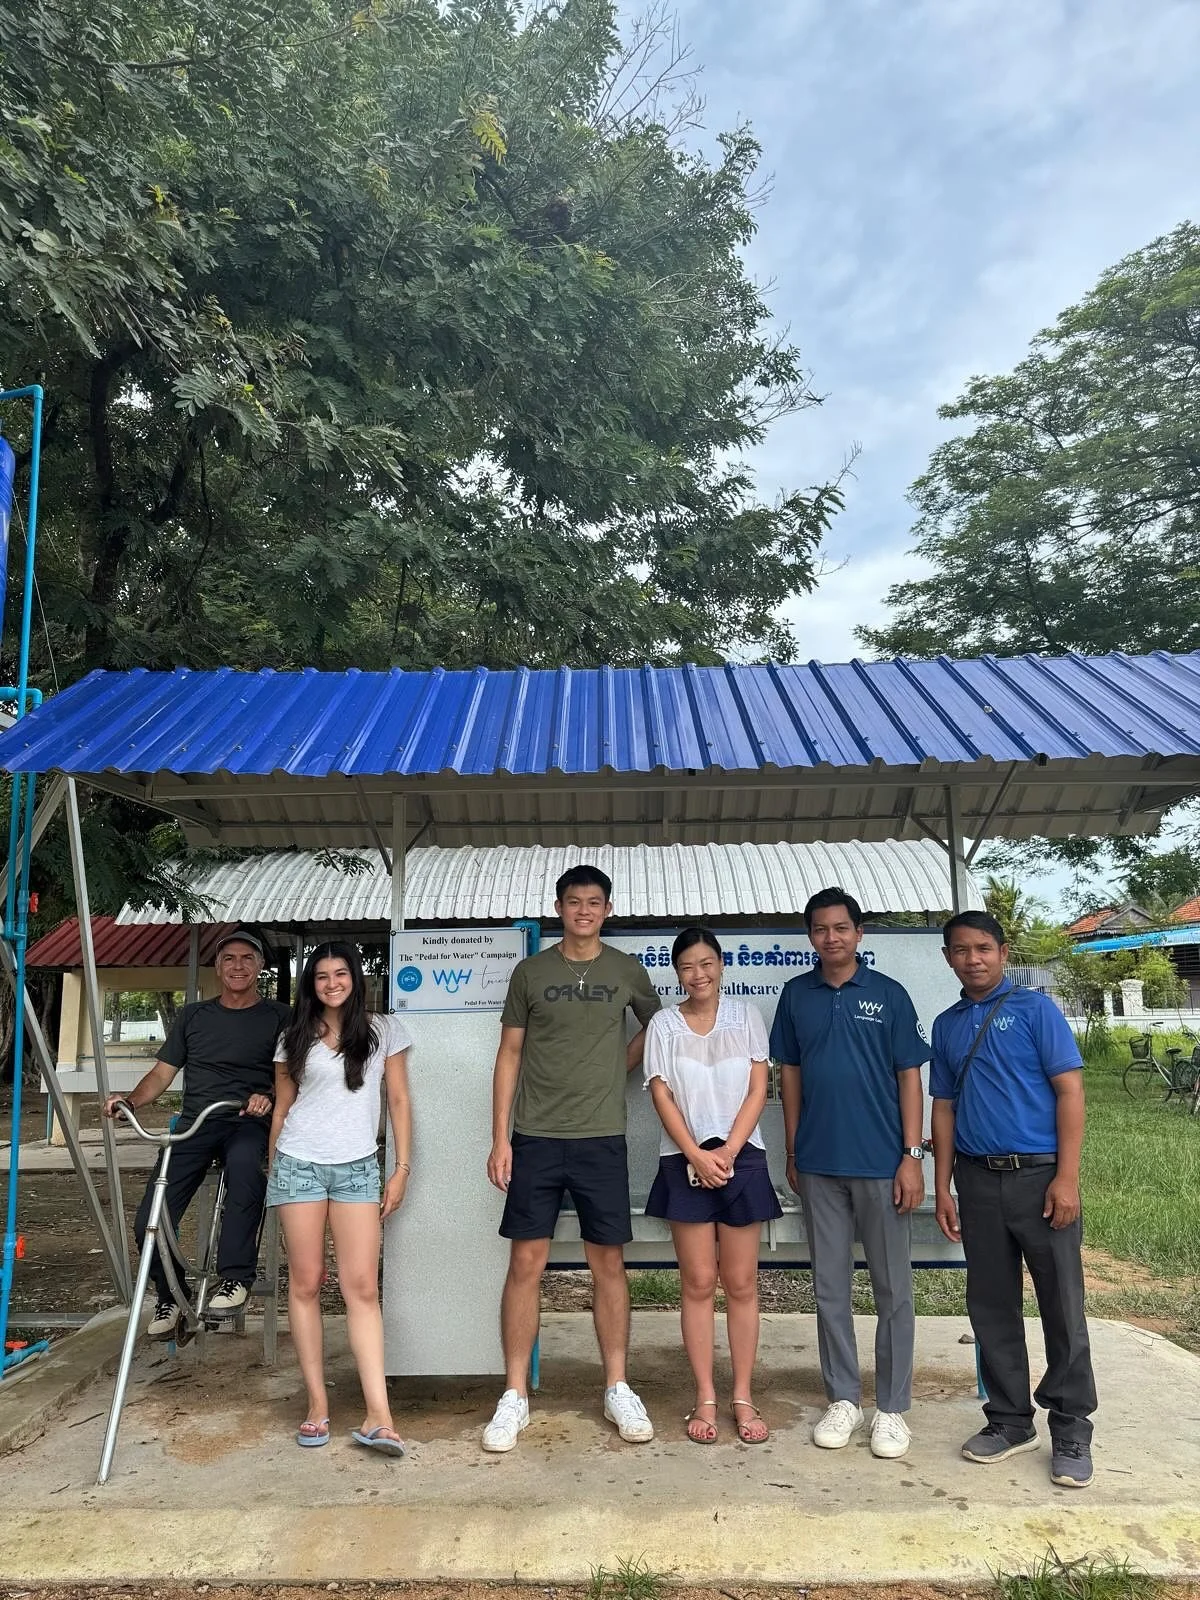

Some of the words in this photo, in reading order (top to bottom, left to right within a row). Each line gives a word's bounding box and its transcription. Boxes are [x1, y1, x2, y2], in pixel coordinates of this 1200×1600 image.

[422, 936, 448, 946] Kindly
[450, 935, 482, 945] donated
[484, 935, 495, 945] by
[398, 953, 413, 962] The
[415, 953, 439, 962] "Pedal
[440, 953, 451, 961] for
[452, 952, 479, 960] Water"
[480, 950, 517, 961] Campaign
[543, 984, 620, 1003] OAKLEY
